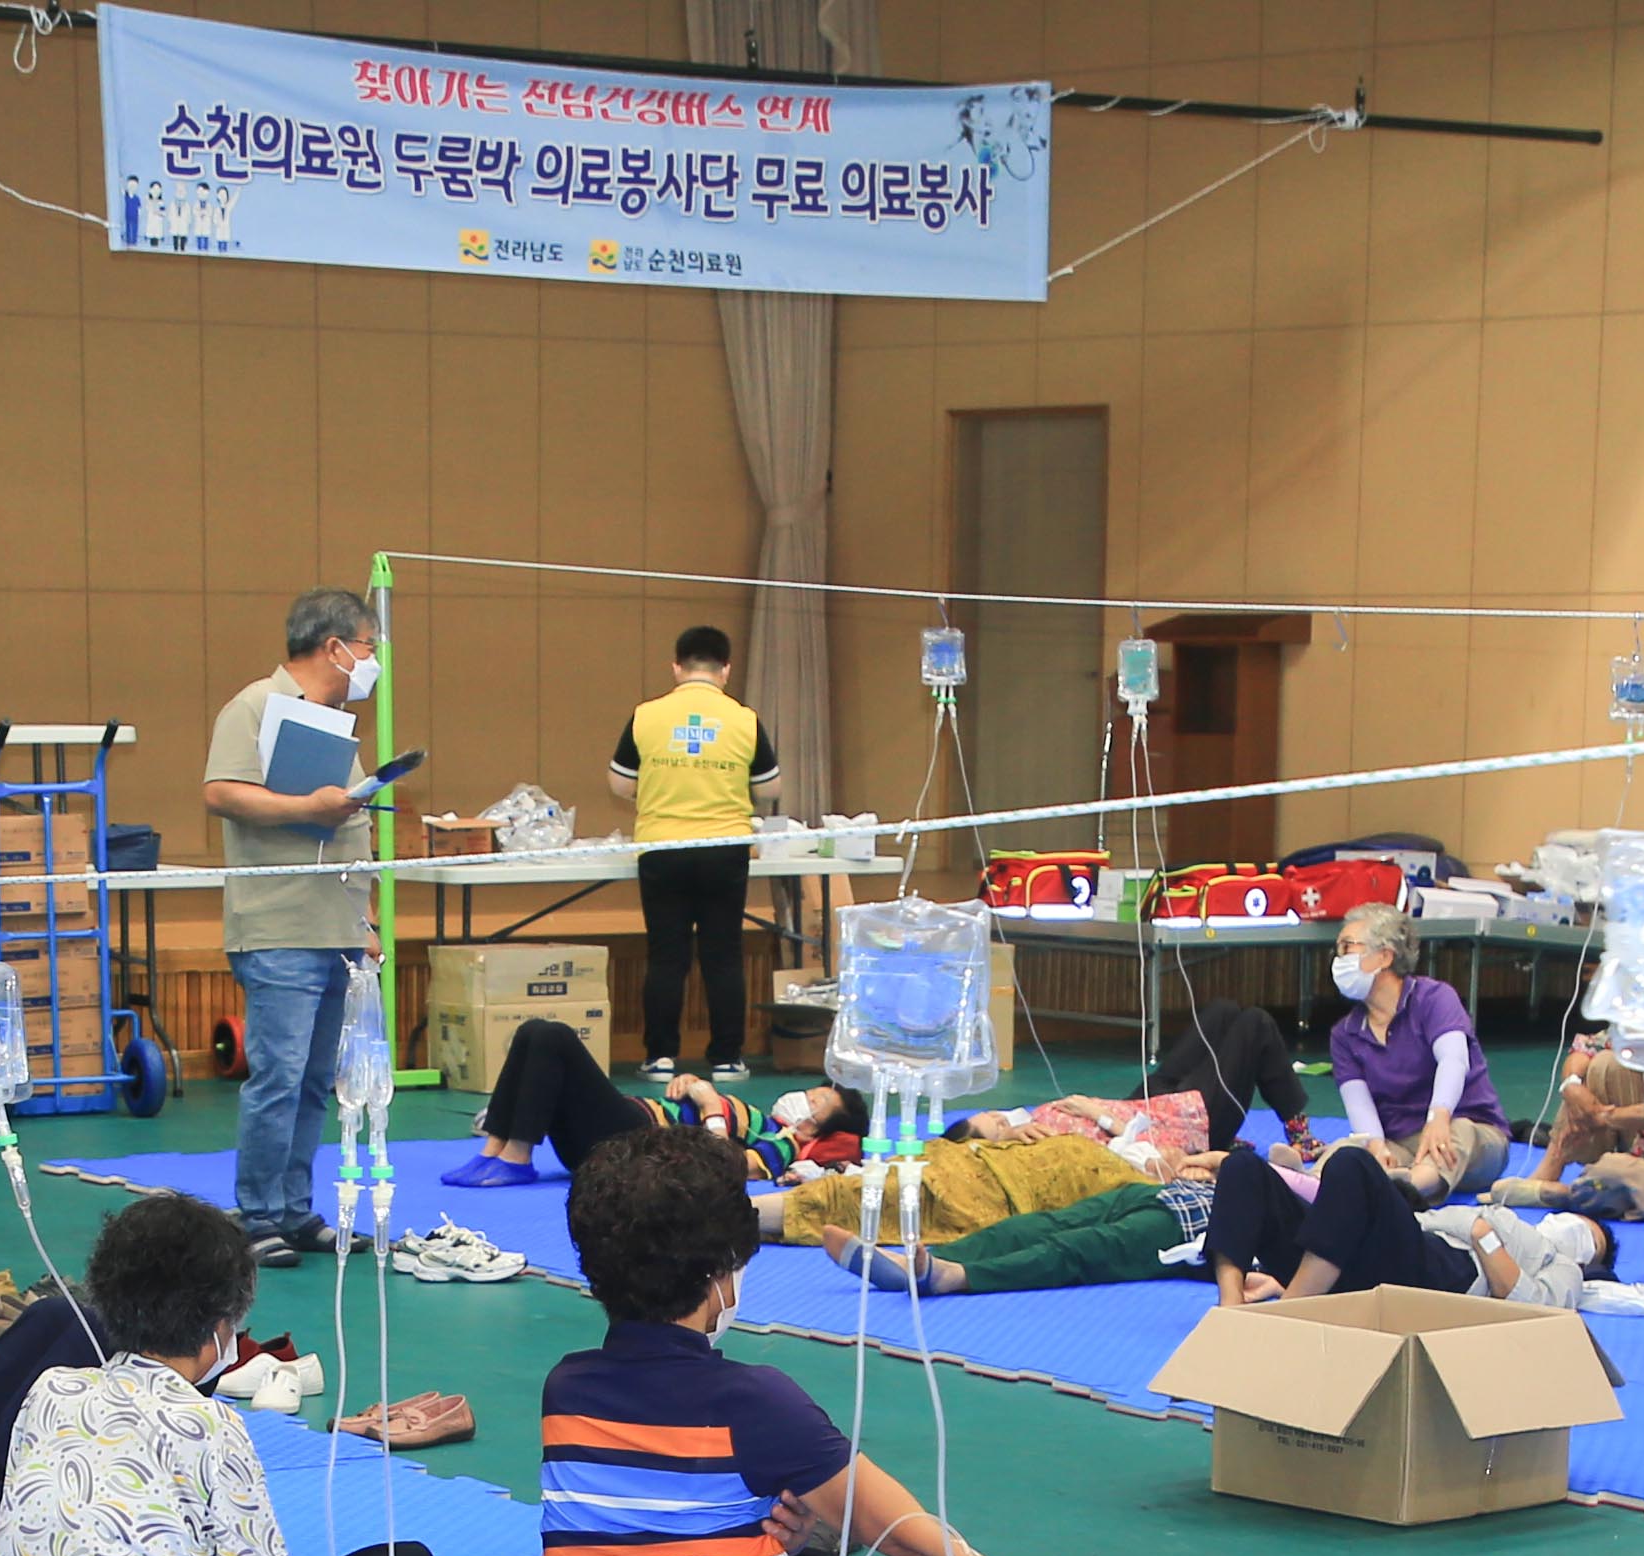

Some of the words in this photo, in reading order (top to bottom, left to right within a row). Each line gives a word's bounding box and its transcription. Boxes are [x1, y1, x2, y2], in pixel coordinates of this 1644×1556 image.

[354, 60, 508, 114] 찾아가는
[525, 77, 745, 128] 전남건강버스
[757, 94, 832, 134] 연계
[161, 104, 382, 189] 순천의료원
[394, 132, 521, 205] 두룸박
[530, 144, 740, 219] 의료봉사단
[752, 157, 829, 220] 무료
[841, 161, 993, 229] 의료봉사
[493, 239, 564, 263] 전라남도
[647, 248, 743, 277] 순천의료원
